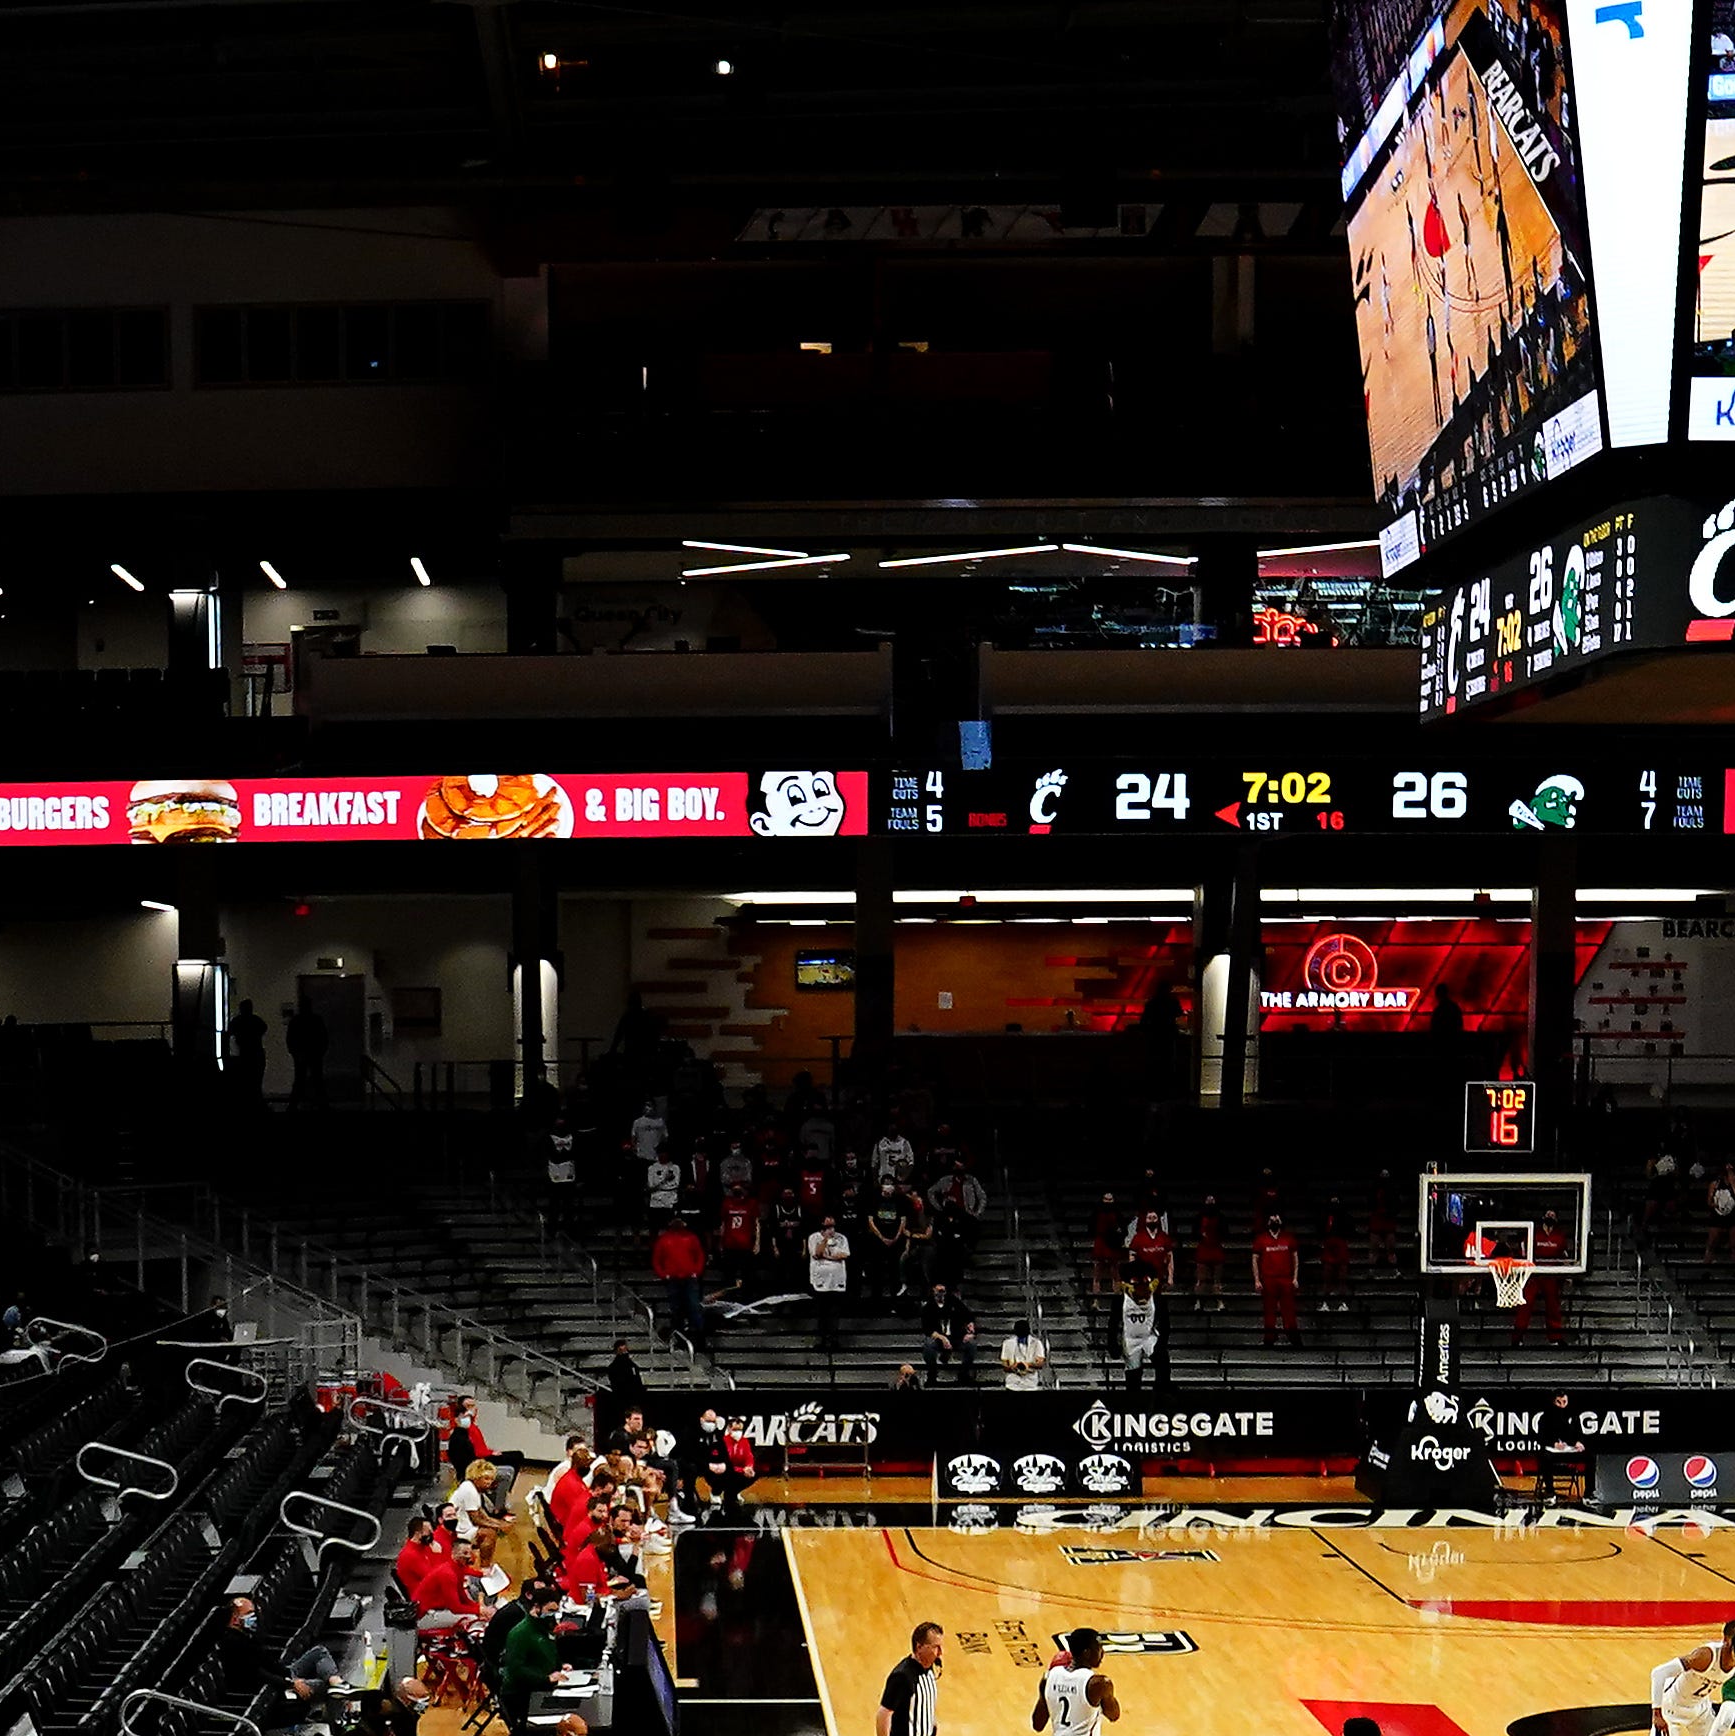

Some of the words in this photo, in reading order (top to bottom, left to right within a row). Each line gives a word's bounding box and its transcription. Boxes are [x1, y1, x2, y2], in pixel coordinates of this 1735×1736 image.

[1529, 545, 1553, 615] 26
[1470, 577, 1491, 642] 24
[1497, 609, 1522, 657] 7:02
[925, 770, 944, 799] 4
[1115, 773, 1191, 820] 24
[1242, 771, 1332, 803] 7:02
[1392, 771, 1468, 819] 26
[1639, 770, 1657, 799] 4
[252, 791, 401, 827] BREAKFAST
[584, 791, 608, 824] &
[614, 789, 660, 823] BIG
[666, 788, 725, 822] BOY.
[926, 804, 943, 832] 5
[1246, 812, 1283, 830] 1ST
[1316, 811, 1344, 830] 16
[1640, 801, 1656, 830] 7
[1260, 991, 1293, 1008] THE
[1296, 991, 1370, 1009] ARMORY
[1374, 991, 1407, 1008] BAR
[1486, 1089, 1526, 1109] 7:02
[1491, 1110, 1519, 1144] 16
[1437, 1323, 1450, 1384] Ameritas
[715, 1402, 881, 1447] ARCATS
[1091, 1411, 1274, 1438] KINGSGATE
[1411, 1436, 1472, 1471] Kroger
[1633, 1489, 1660, 1500] pepsi
[1690, 1488, 1718, 1499] pepsi
[1059, 1696, 1071, 1727] 2
